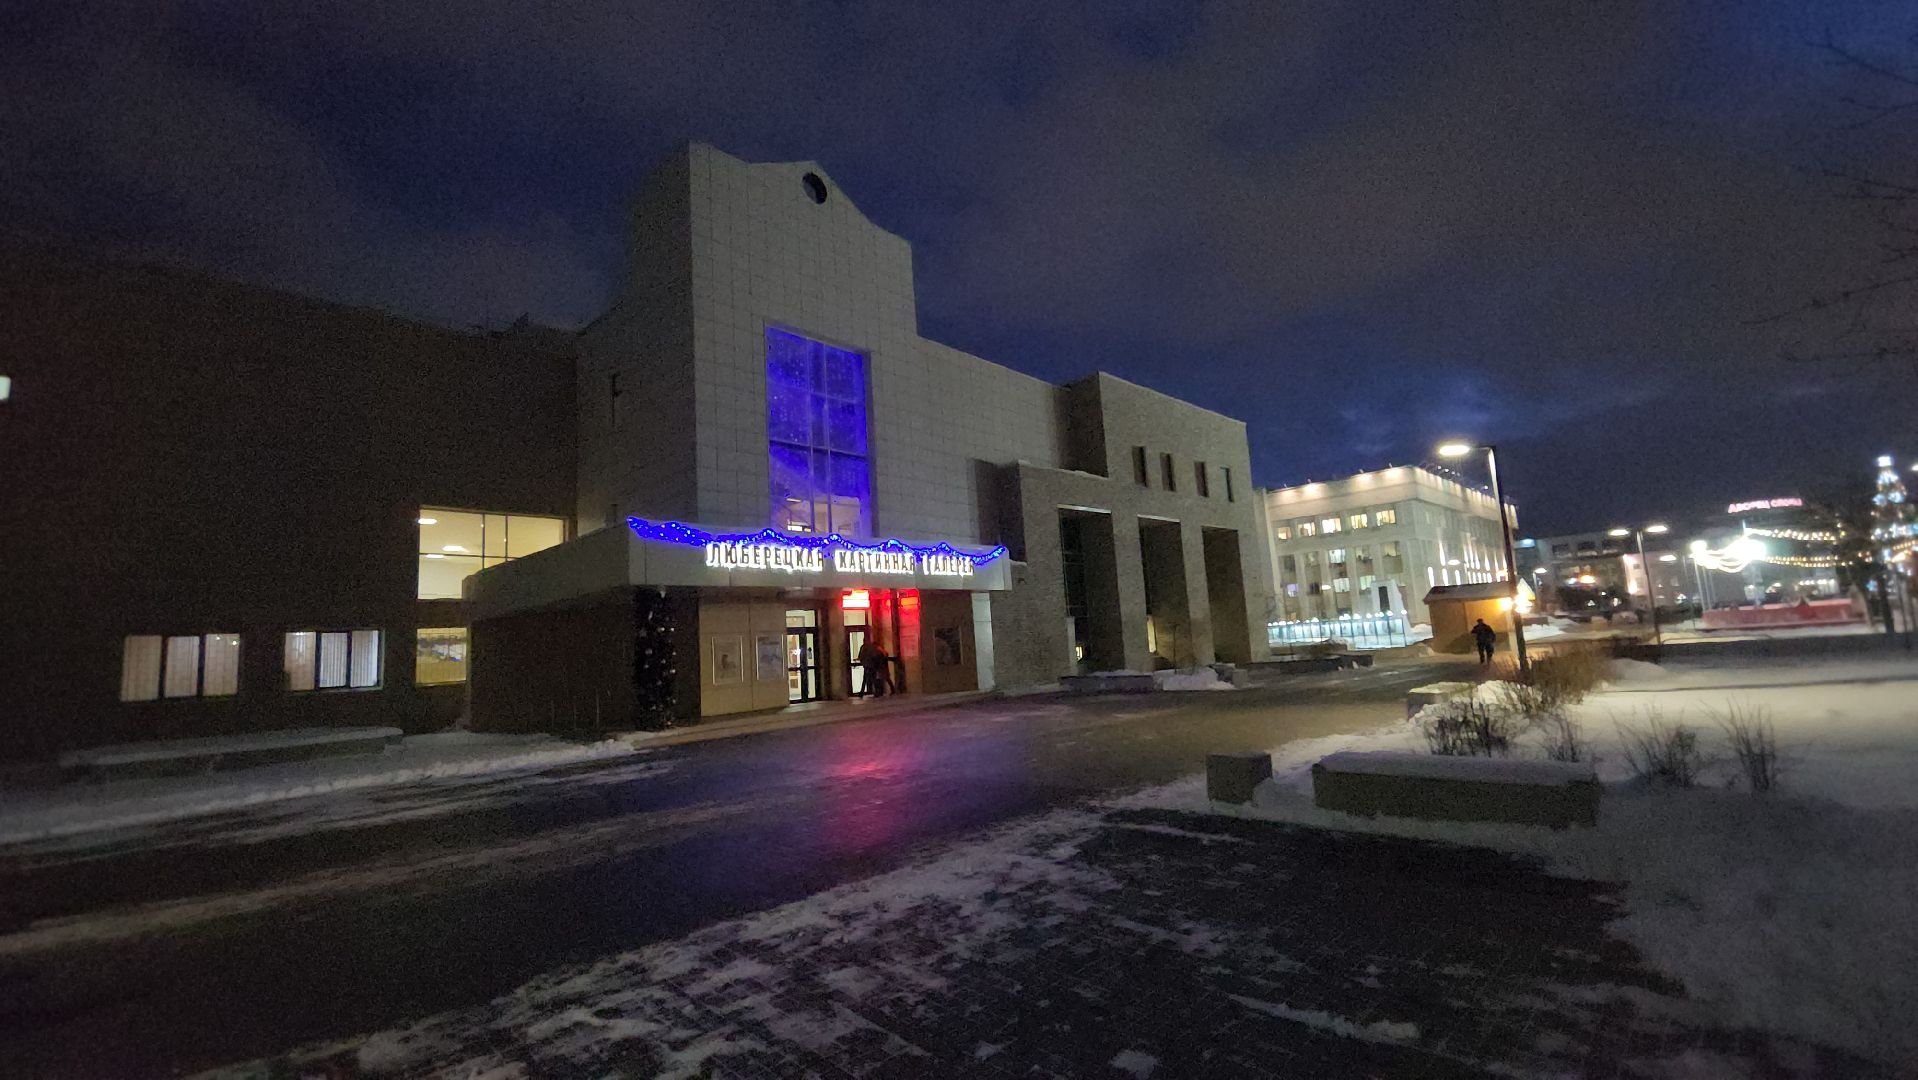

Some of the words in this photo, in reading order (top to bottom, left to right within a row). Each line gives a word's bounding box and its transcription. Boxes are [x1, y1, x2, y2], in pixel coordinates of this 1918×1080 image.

[706, 542, 823, 573] ЛЮБЕРЕЦКАЯ
[836, 550, 915, 574] КАРТИННАЯ
[922, 555, 974, 576] ГАЛЕРЕЯ
